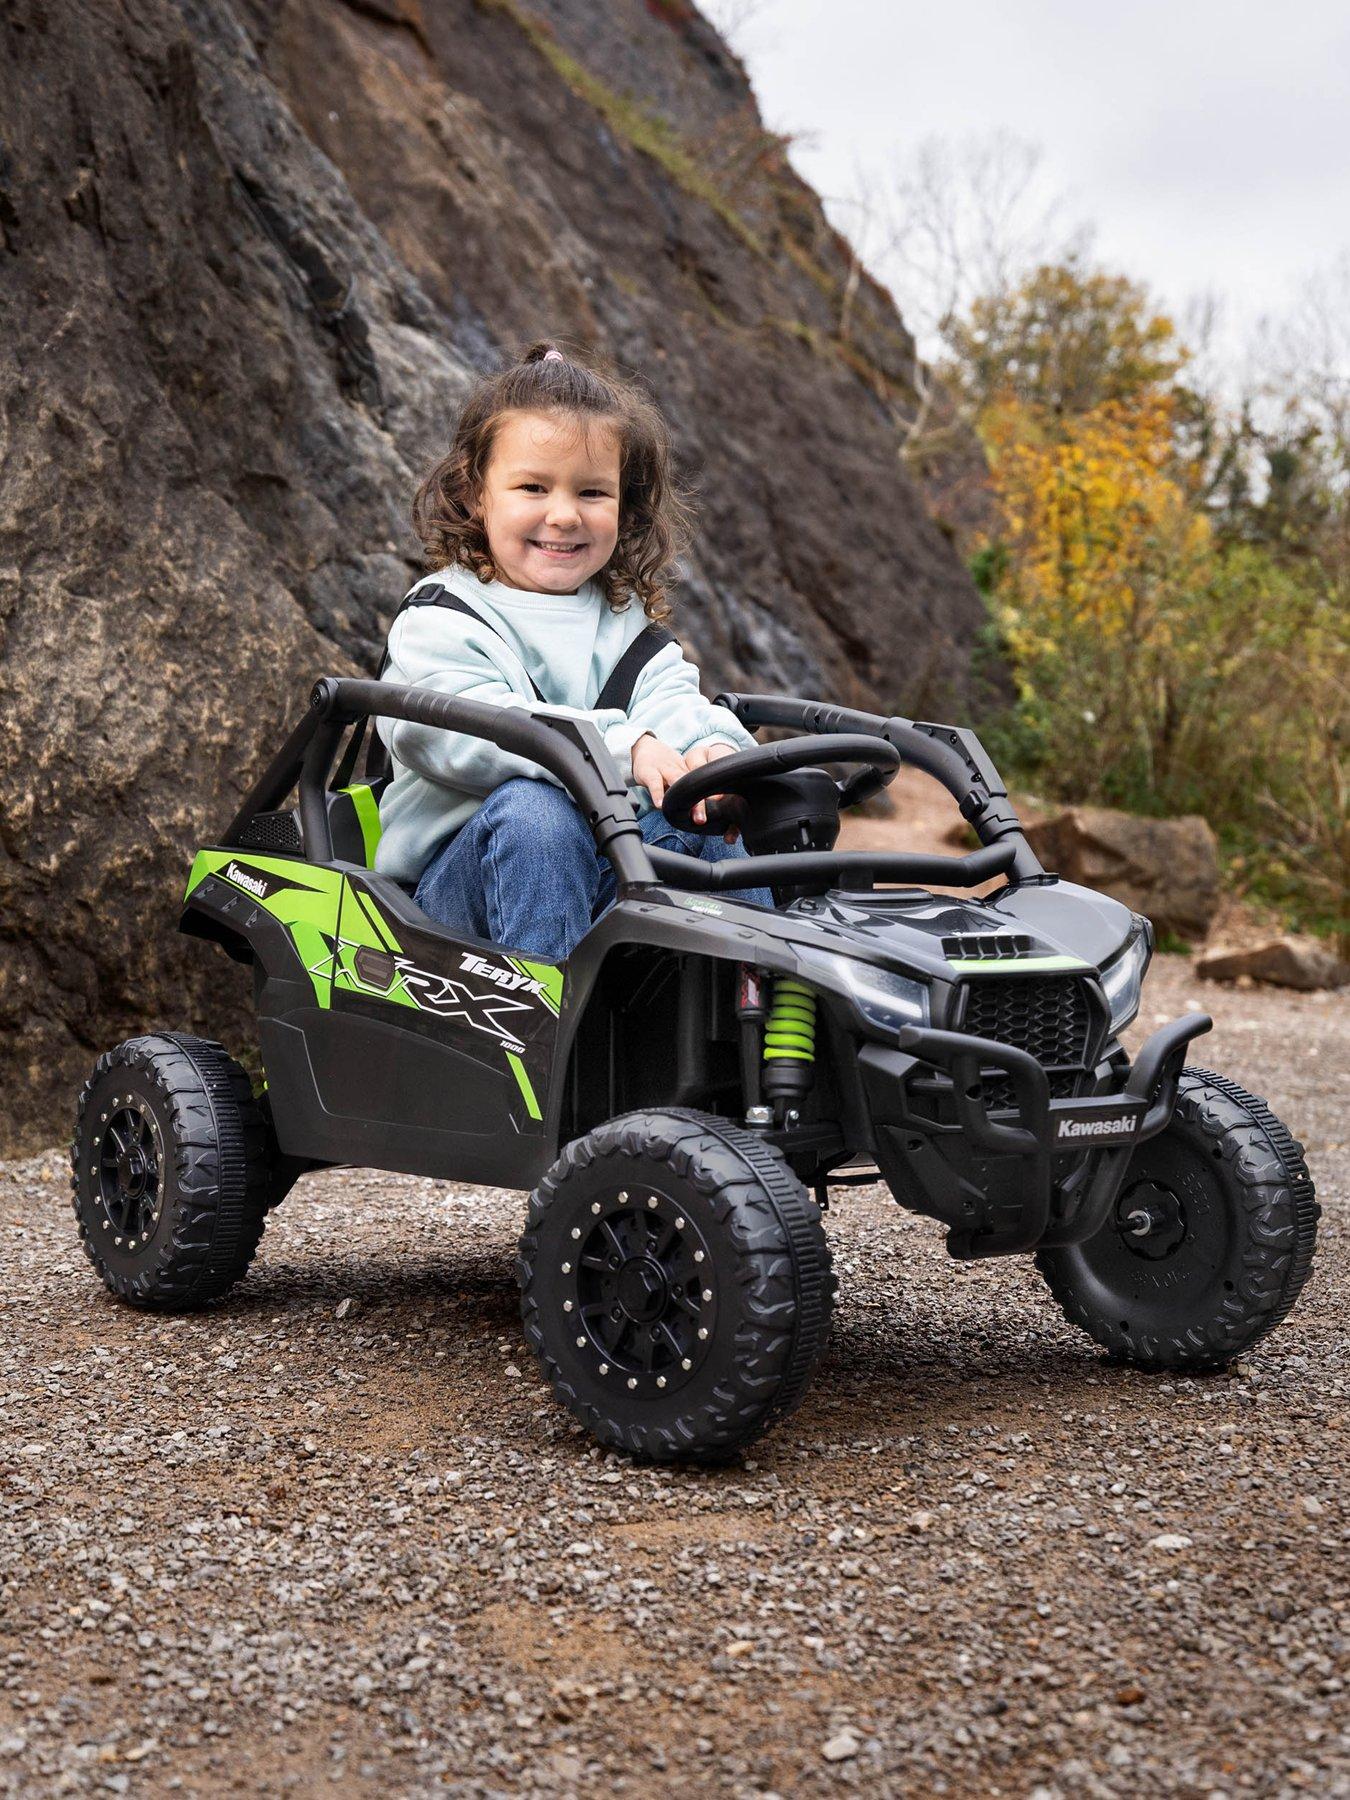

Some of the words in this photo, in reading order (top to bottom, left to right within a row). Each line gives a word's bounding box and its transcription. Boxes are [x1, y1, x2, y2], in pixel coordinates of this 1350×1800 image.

[225, 862, 268, 898] Kawasaki
[500, 1040, 526, 1054] 1000
[1058, 1115, 1137, 1138] Kawasaki
